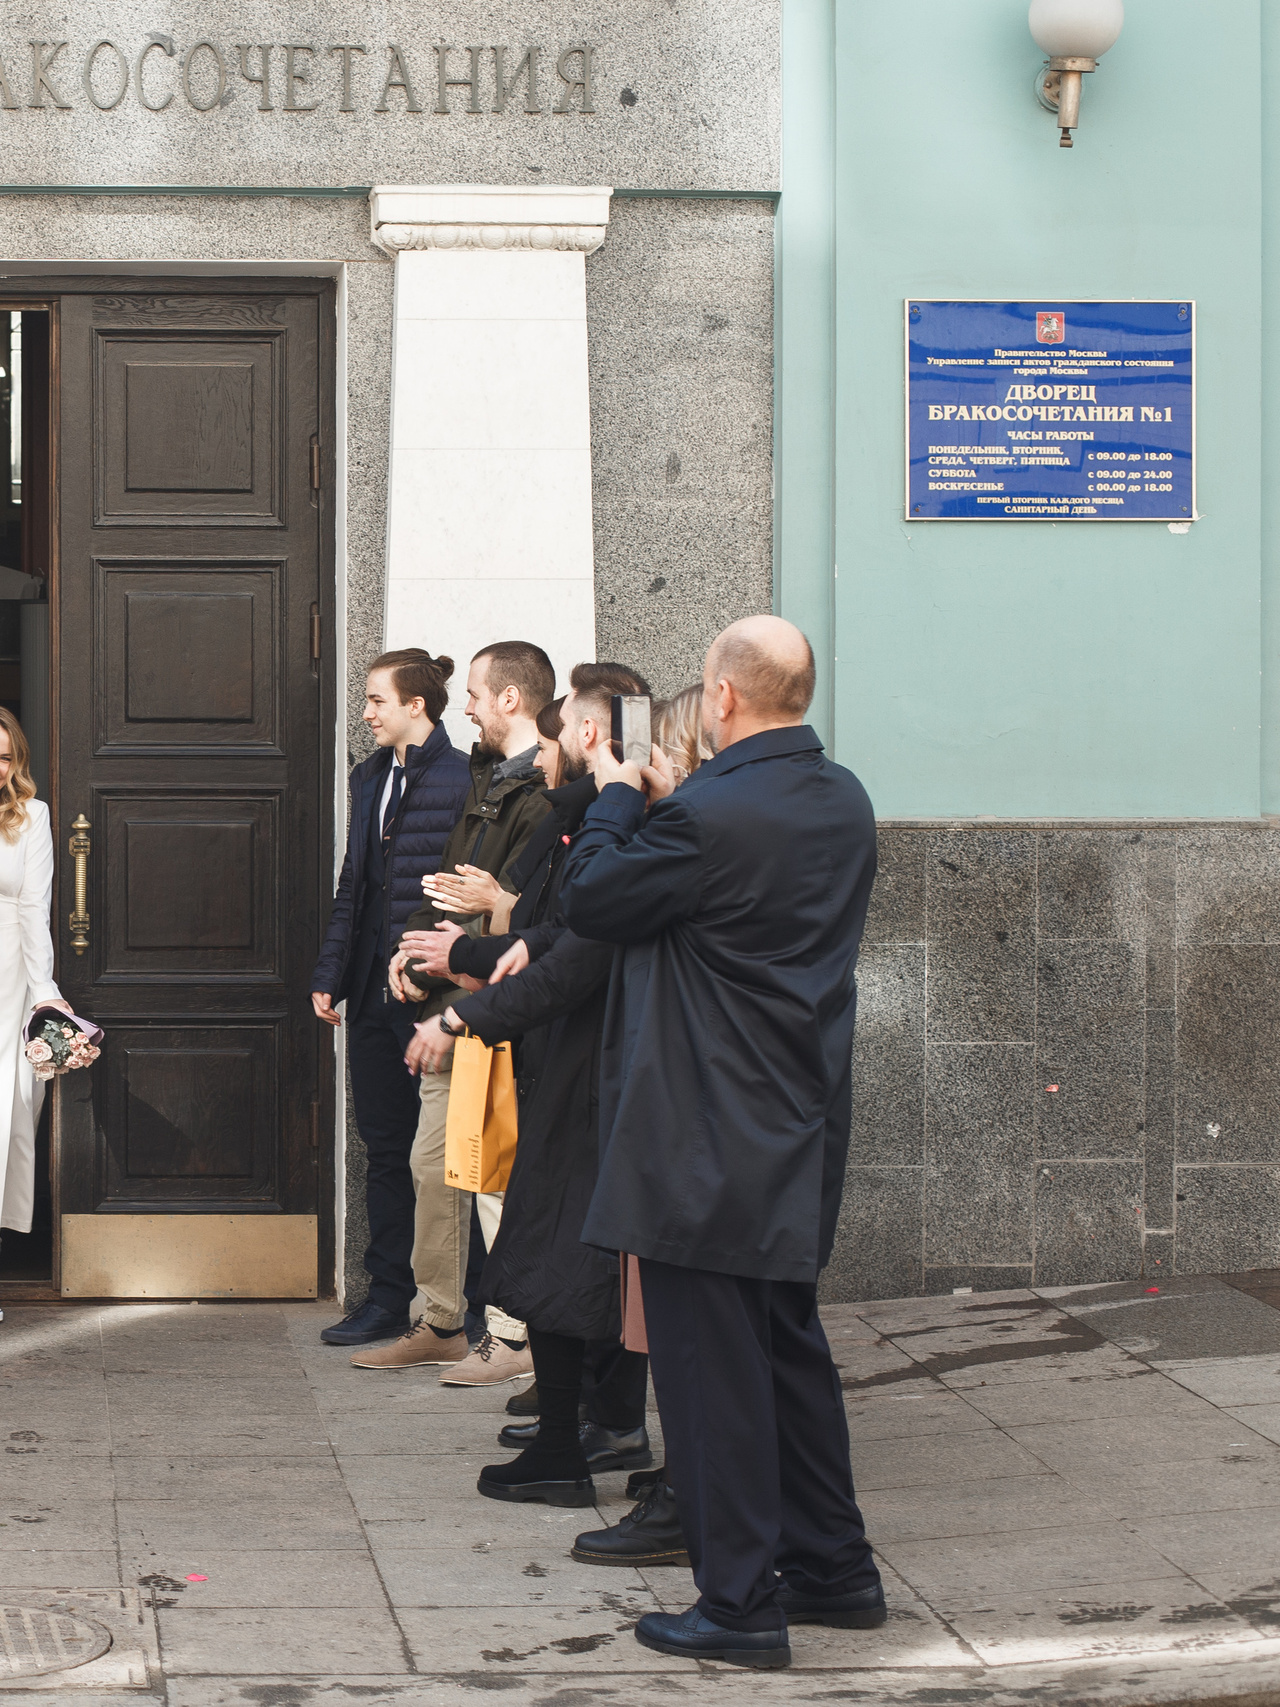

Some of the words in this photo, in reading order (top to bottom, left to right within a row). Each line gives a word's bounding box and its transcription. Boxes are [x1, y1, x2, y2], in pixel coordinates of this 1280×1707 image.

[994, 349, 1066, 358] Правительство
[1068, 349, 1107, 357] Москвы
[927, 357, 984, 366] Управление
[1053, 359, 1122, 367] гражданского
[1014, 368, 1047, 376] города
[1050, 367, 1088, 375] Москвы
[1004, 385, 1096, 404] ДВОРЕЦ
[928, 406, 1134, 422] БРАКОСОЧЕТАНИЯ
[1140, 406, 1172, 422] №1
[1007, 431, 1042, 440] ЧАСЫ
[1046, 431, 1094, 440] РАБОТЫ
[928, 446, 1009, 455] ПОНЕДЕЛЬНИК,
[1012, 446, 1064, 455] ВТОРНИК,
[928, 456, 966, 466] СРЕДА,
[970, 457, 1017, 466] ЧЕТВЕРГ,
[1020, 457, 1070, 466] ПЯТНИЦА
[1096, 452, 1126, 461] 09.00
[1127, 454, 1141, 462] до
[1144, 452, 1172, 461] 18.00
[928, 470, 976, 478] СУББОТА
[1096, 470, 1126, 479] 09.00
[1127, 472, 1141, 480] до
[1144, 470, 1172, 479] 24.00
[928, 482, 1004, 491] ВОСКРЕСЕНЬЕ
[1096, 483, 1126, 492] 00.00
[1127, 485, 1141, 493] до
[1144, 483, 1172, 492] 18.00
[977, 496, 1010, 504] ПЕРВЫЙ
[1050, 497, 1089, 505] КАЖДОГО
[1091, 497, 1124, 505] МЕСЯЦА
[1004, 504, 1069, 514] САНИТАРНЫЙ
[1070, 506, 1097, 514] ДЕНЬ
